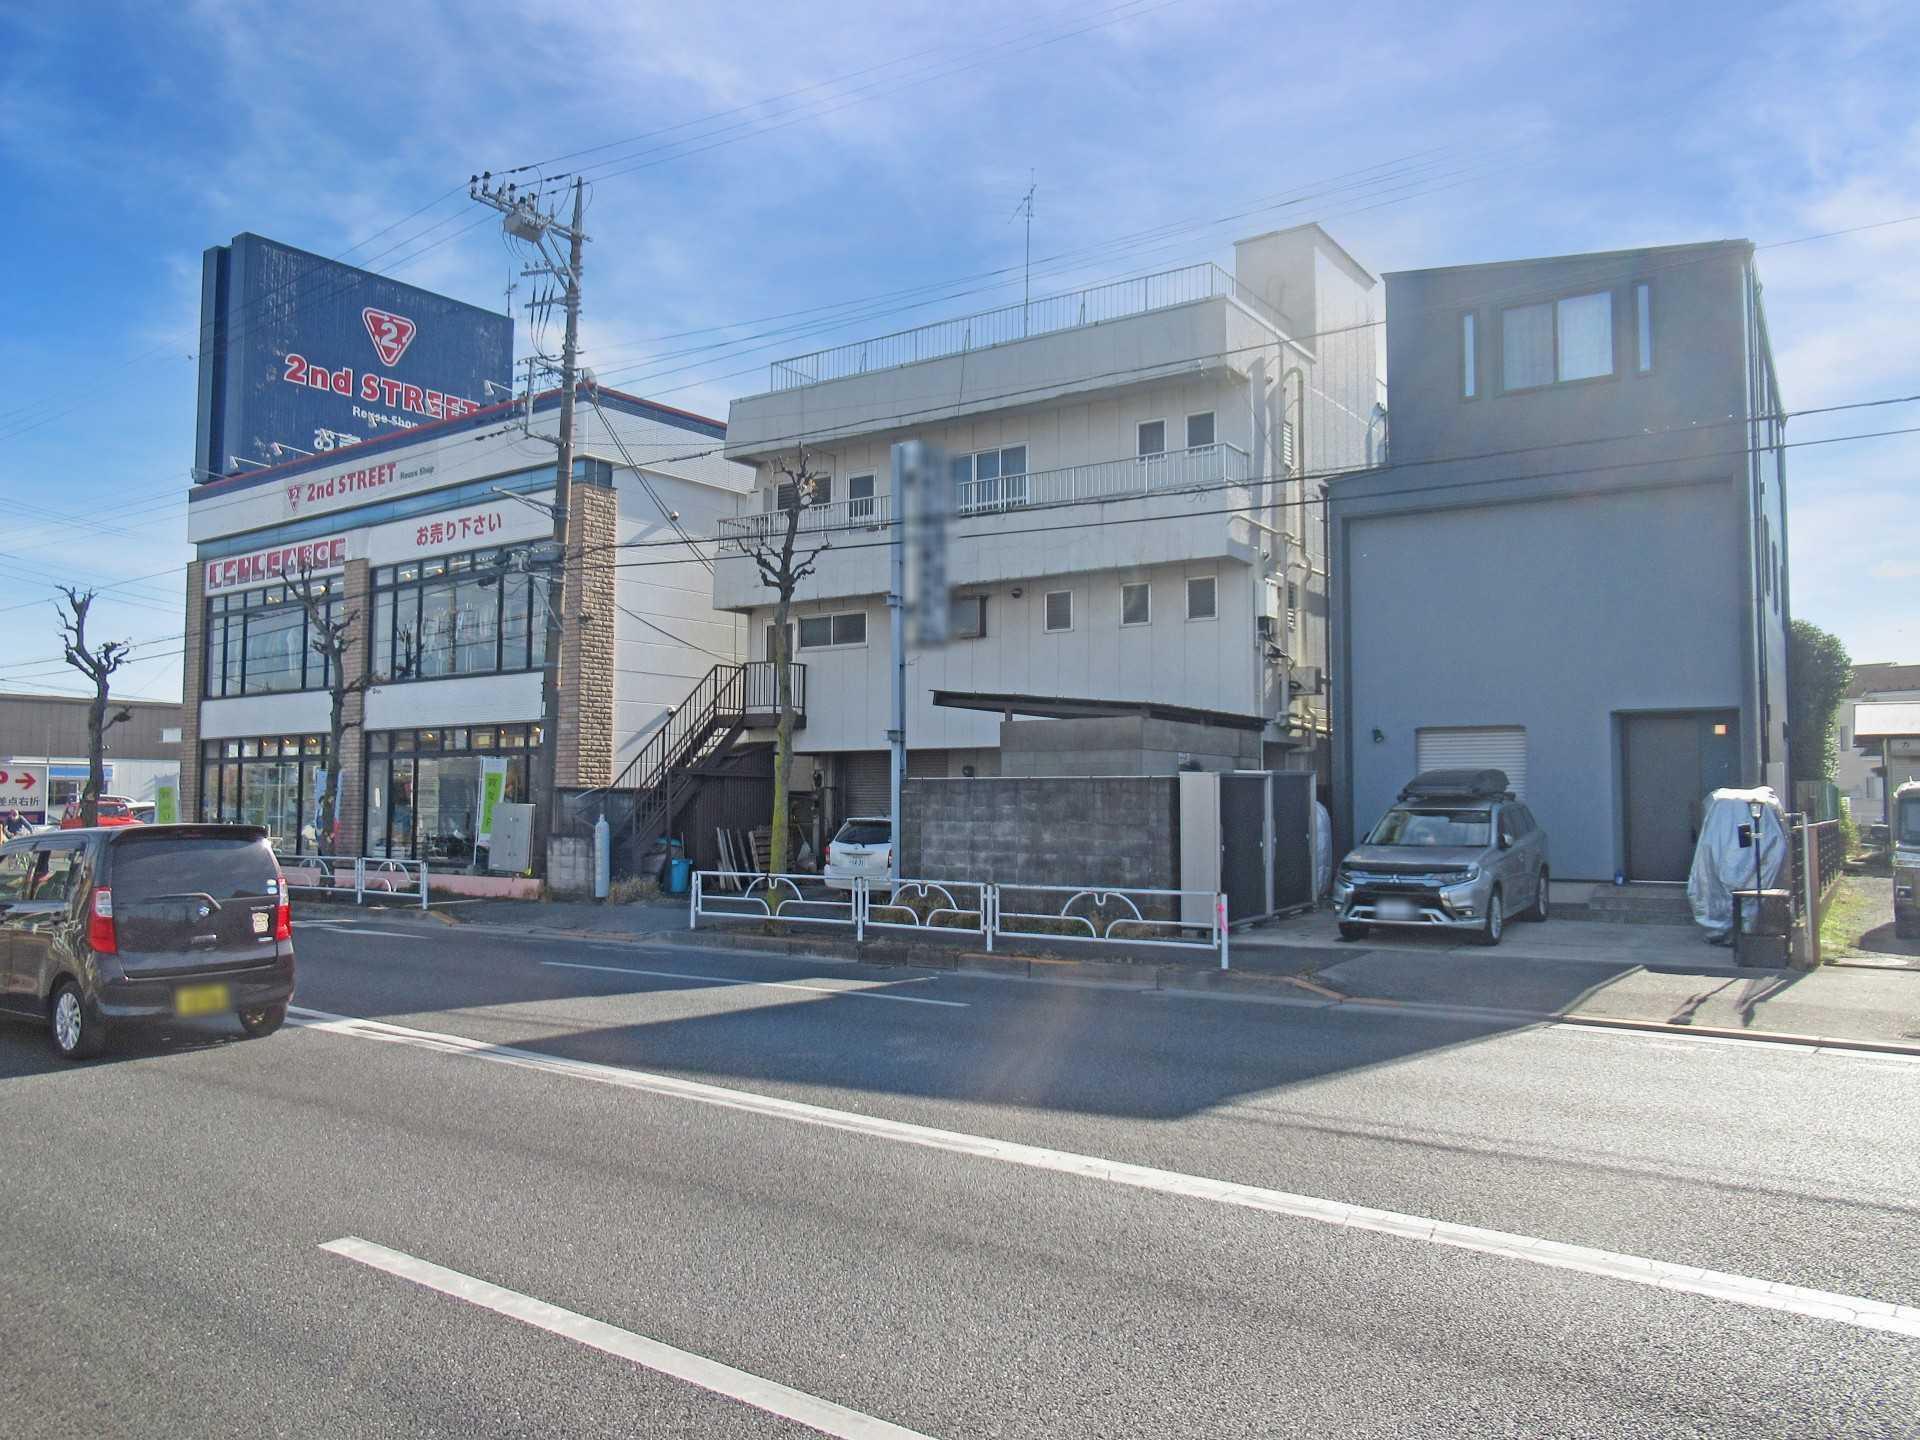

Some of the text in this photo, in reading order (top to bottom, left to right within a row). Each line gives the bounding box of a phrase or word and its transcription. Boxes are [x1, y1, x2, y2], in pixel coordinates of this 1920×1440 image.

[284, 353, 353, 397] 2nd
[307, 477, 335, 502] 2nd
[338, 462, 398, 494] STREET
[415, 511, 502, 546] お売り下さい
